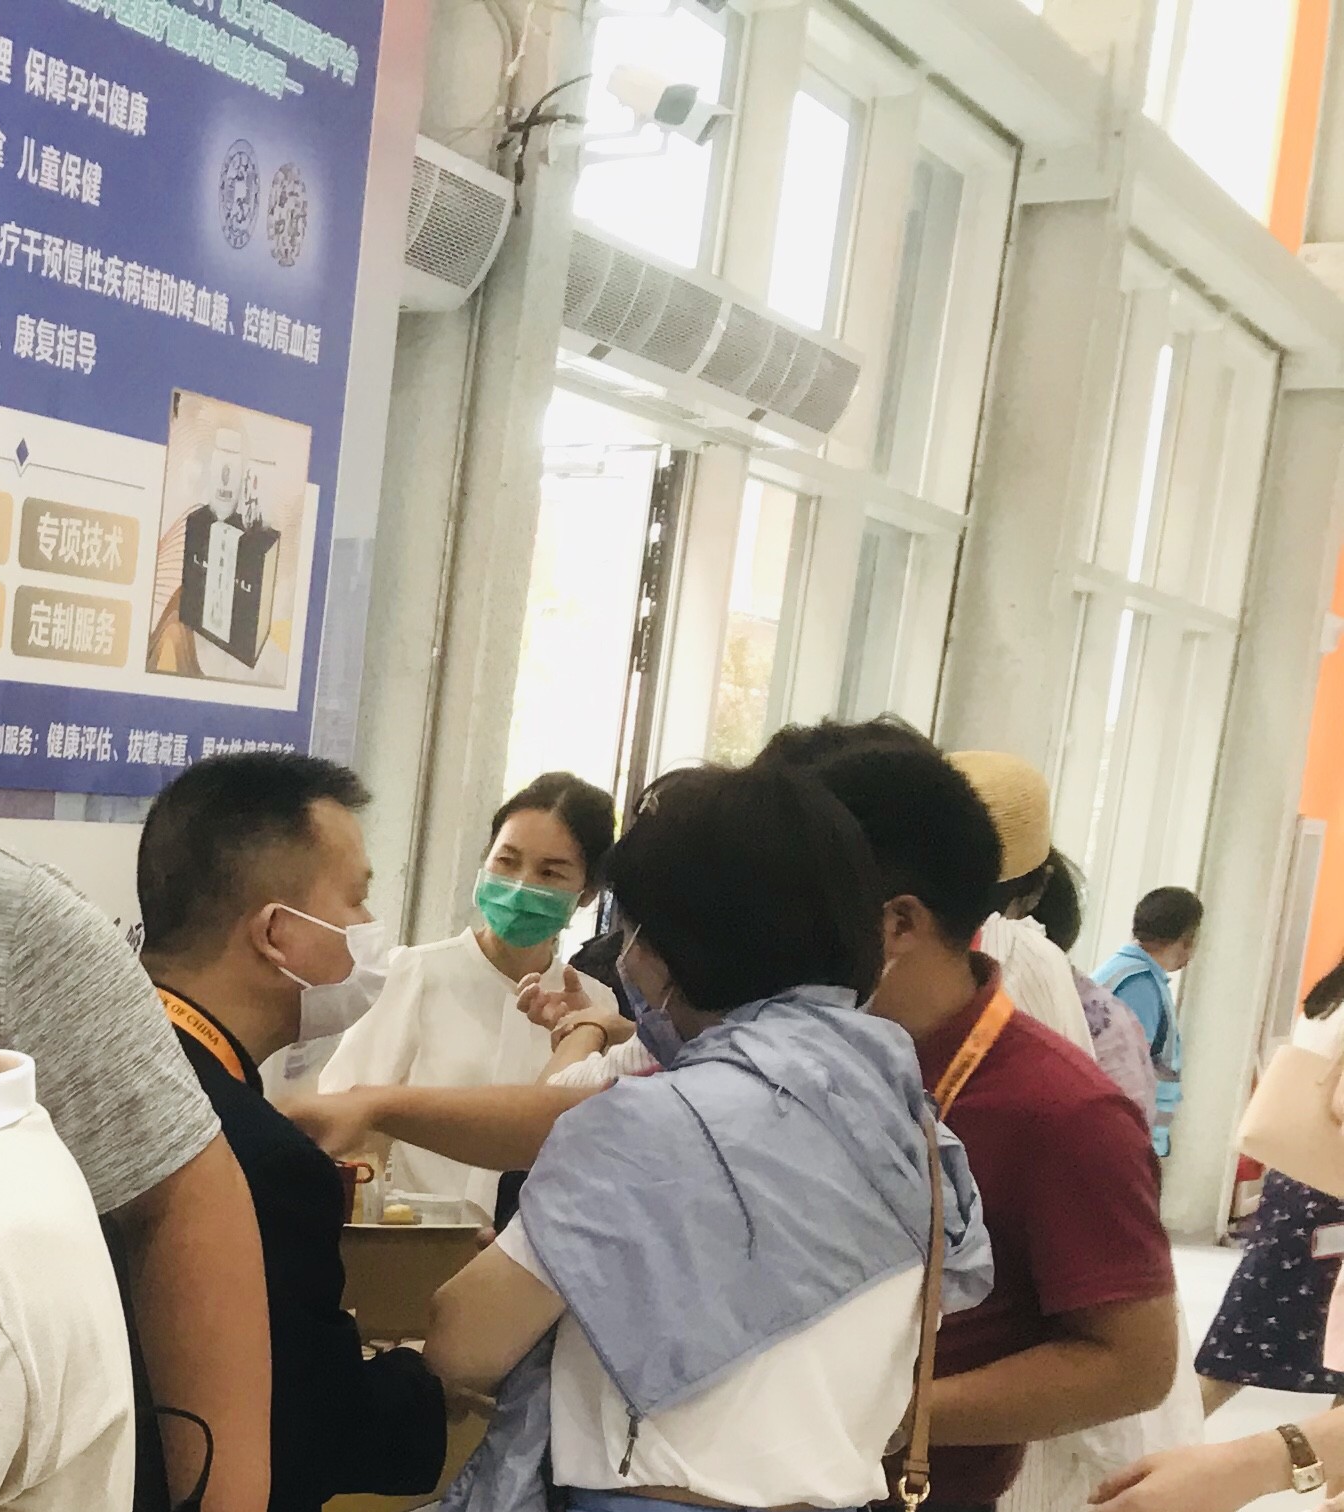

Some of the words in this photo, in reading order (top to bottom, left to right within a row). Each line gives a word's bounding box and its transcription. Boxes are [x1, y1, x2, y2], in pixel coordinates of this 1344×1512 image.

[24, 47, 149, 137] 保障孕妇健康
[17, 135, 103, 207] 儿童保健
[36, 510, 124, 568] 专项技术
[28, 600, 117, 657] 定制服务
[187, 1014, 220, 1046] CHINA
